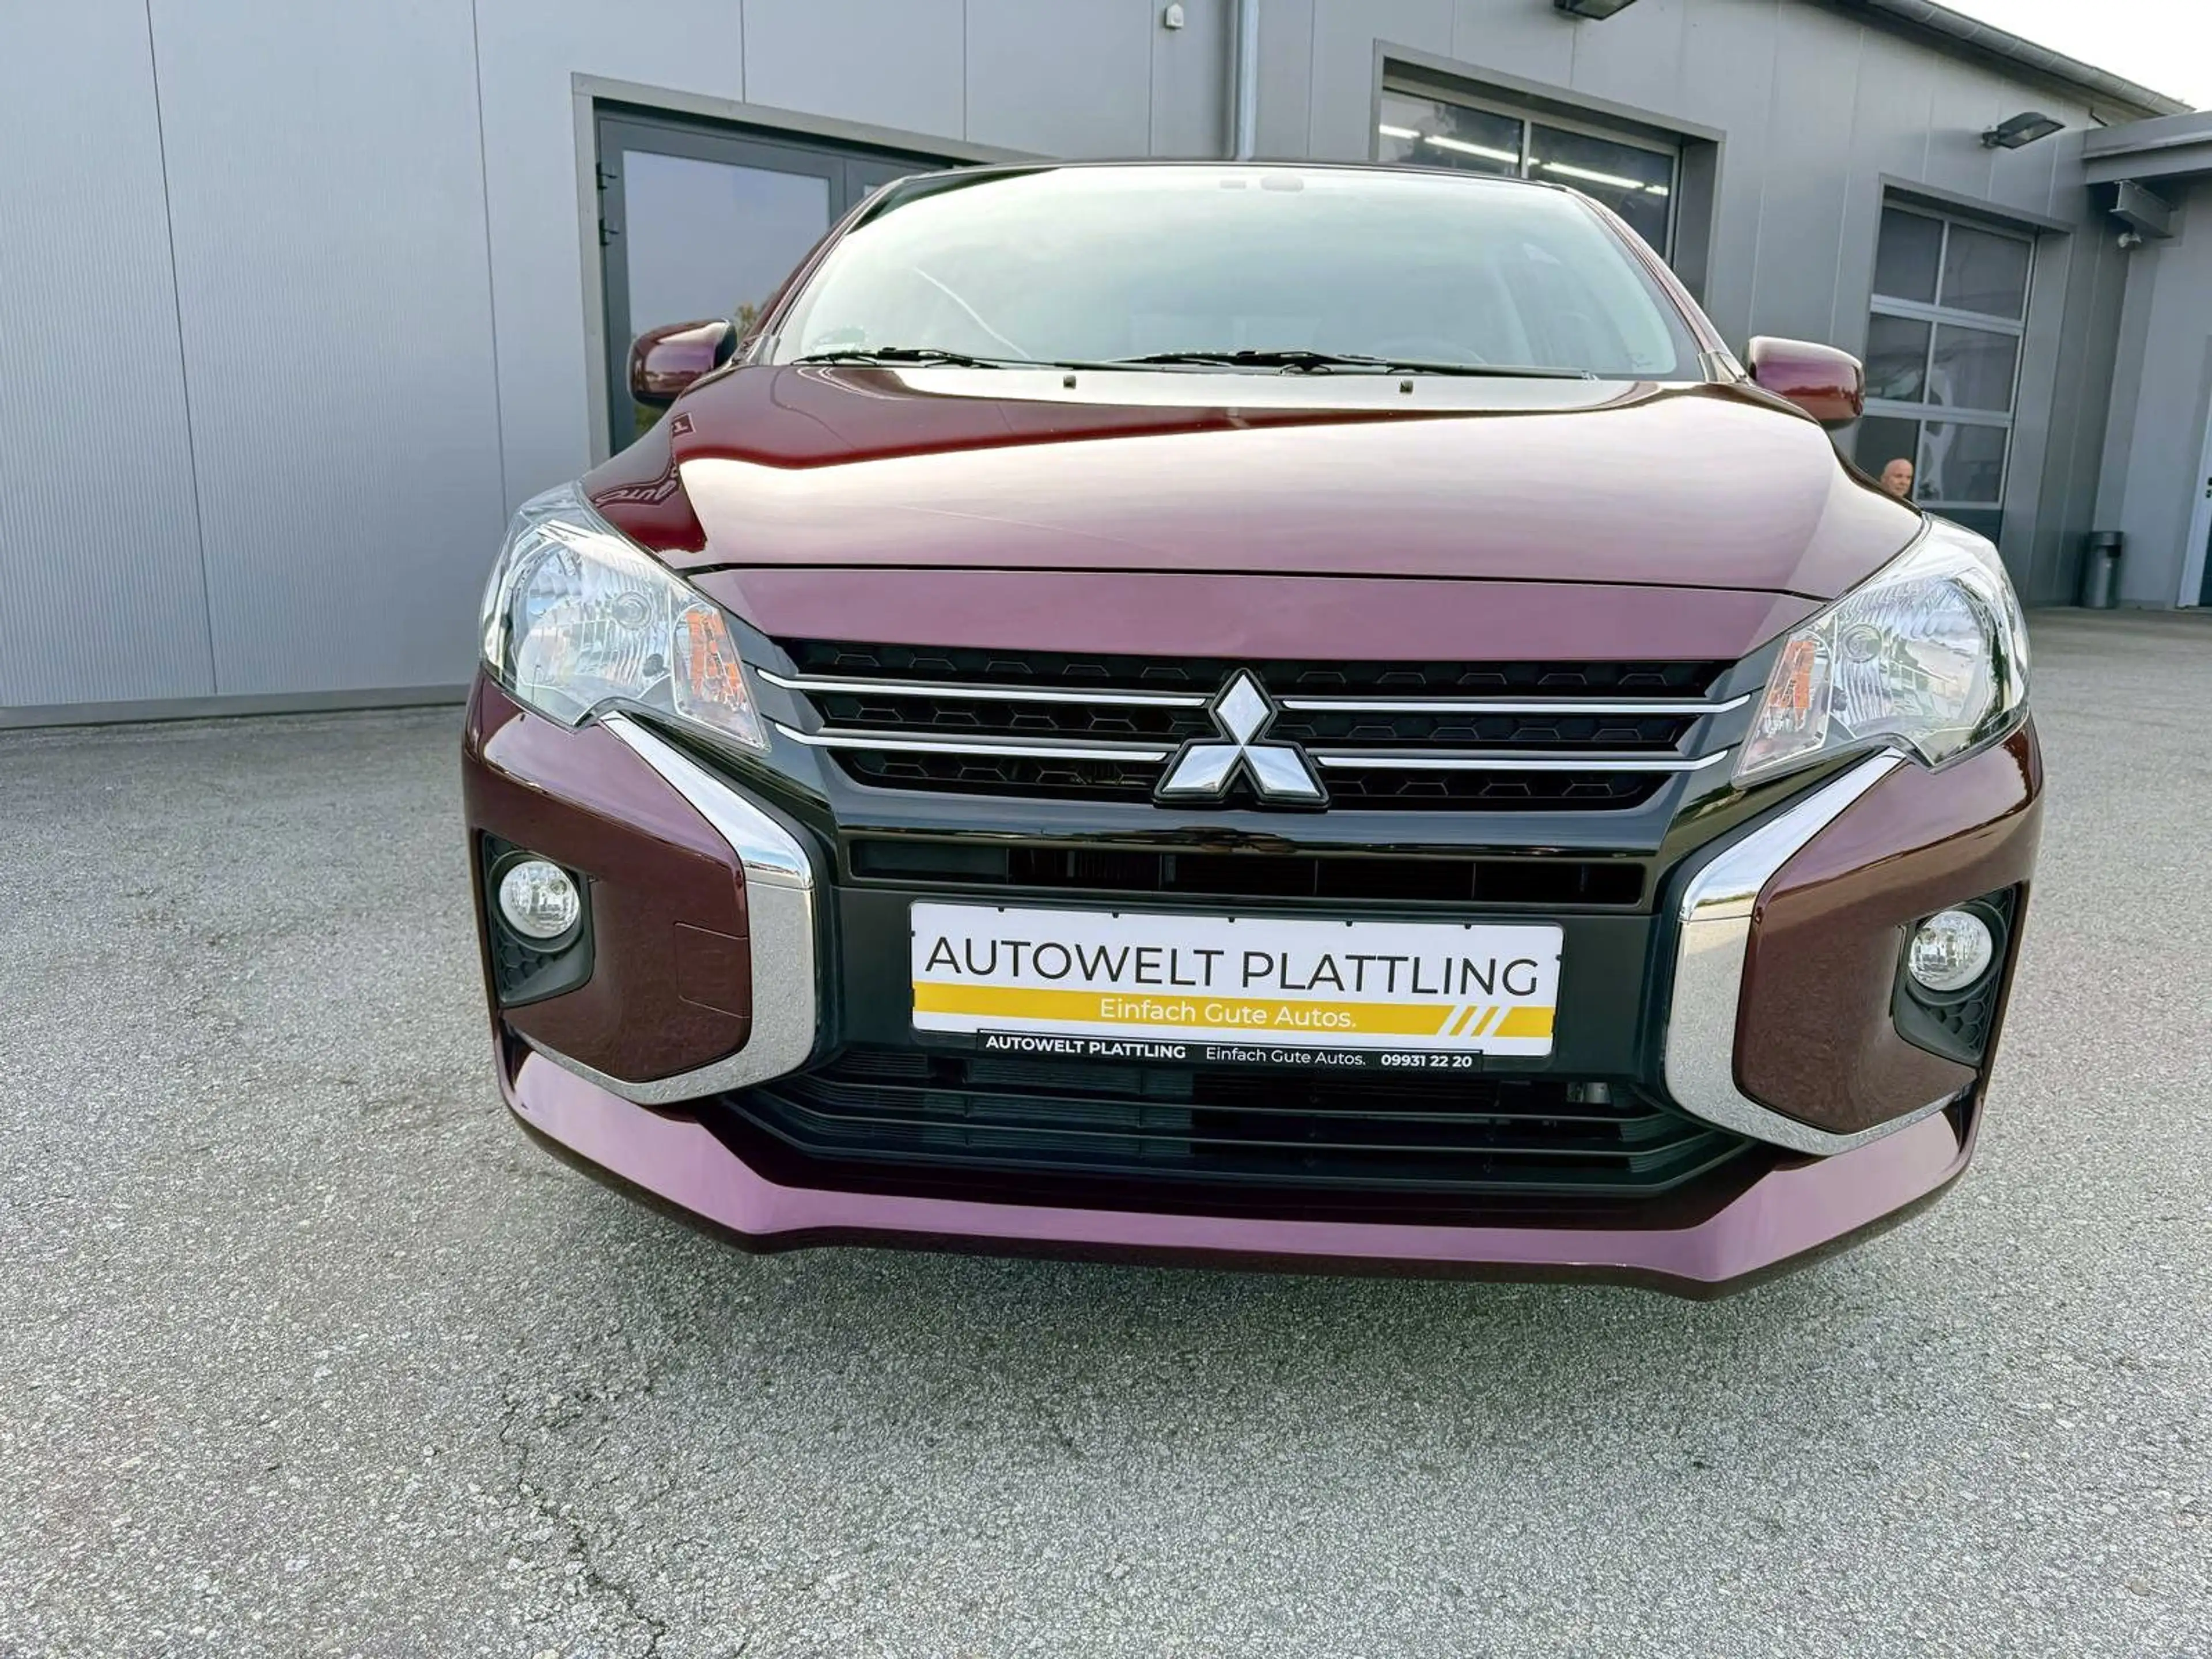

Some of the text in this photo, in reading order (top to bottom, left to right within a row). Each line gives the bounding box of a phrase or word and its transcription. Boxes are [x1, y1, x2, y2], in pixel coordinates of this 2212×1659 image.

[925, 936, 1538, 997] AUTOWELT PLATTLING
[1100, 998, 1357, 1028] Einfach Gute Autos.
[986, 1035, 1472, 1067] AUTOWELT PLATTLING Einfach Gute Autos. 09931 22 20
